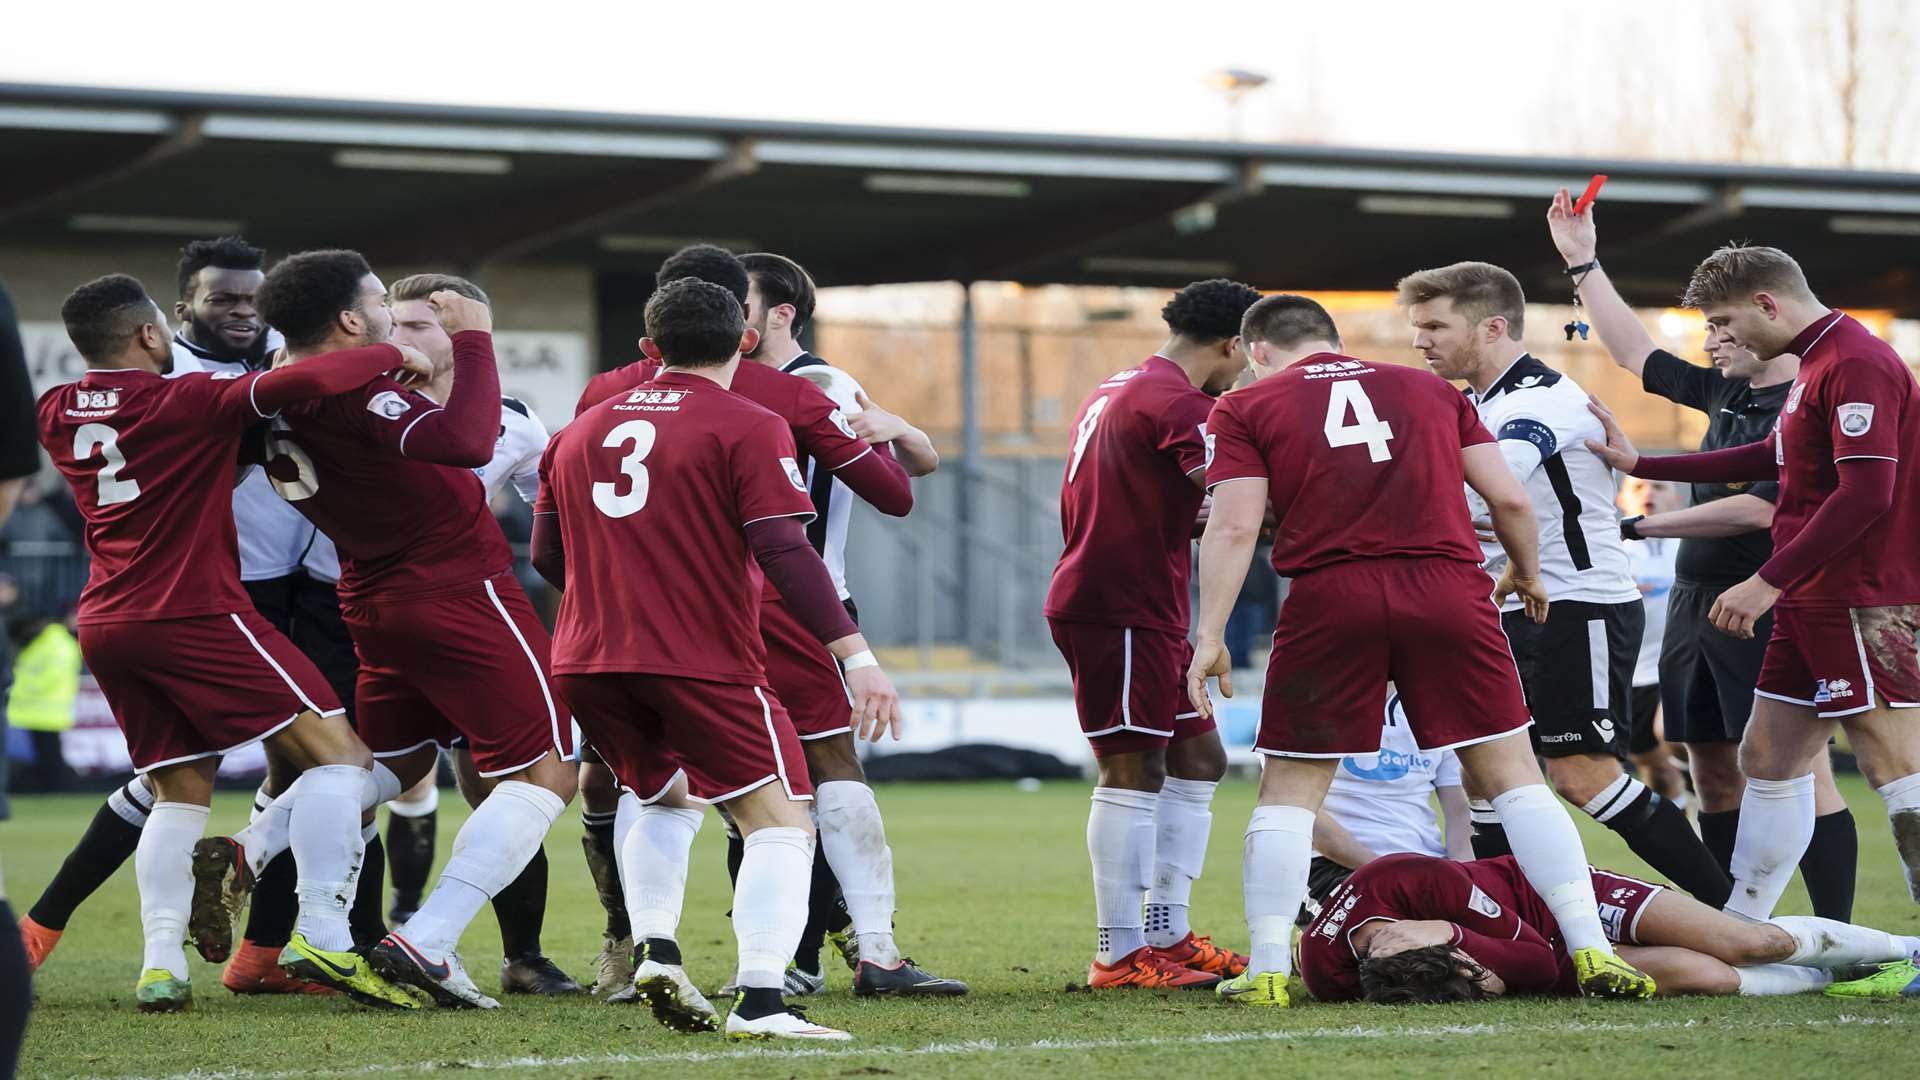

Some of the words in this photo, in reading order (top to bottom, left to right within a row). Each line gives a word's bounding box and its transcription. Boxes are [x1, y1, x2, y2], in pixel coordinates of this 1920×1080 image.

[612, 404, 680, 412] SCAFFOLDING
[625, 391, 685, 404] D&B
[1303, 367, 1377, 380] SCAFFOLDING
[265, 414, 320, 501] 5
[1067, 395, 1109, 484] 9
[1323, 379, 1395, 464] 4
[73, 422, 141, 507] 2
[592, 419, 656, 519] 3
